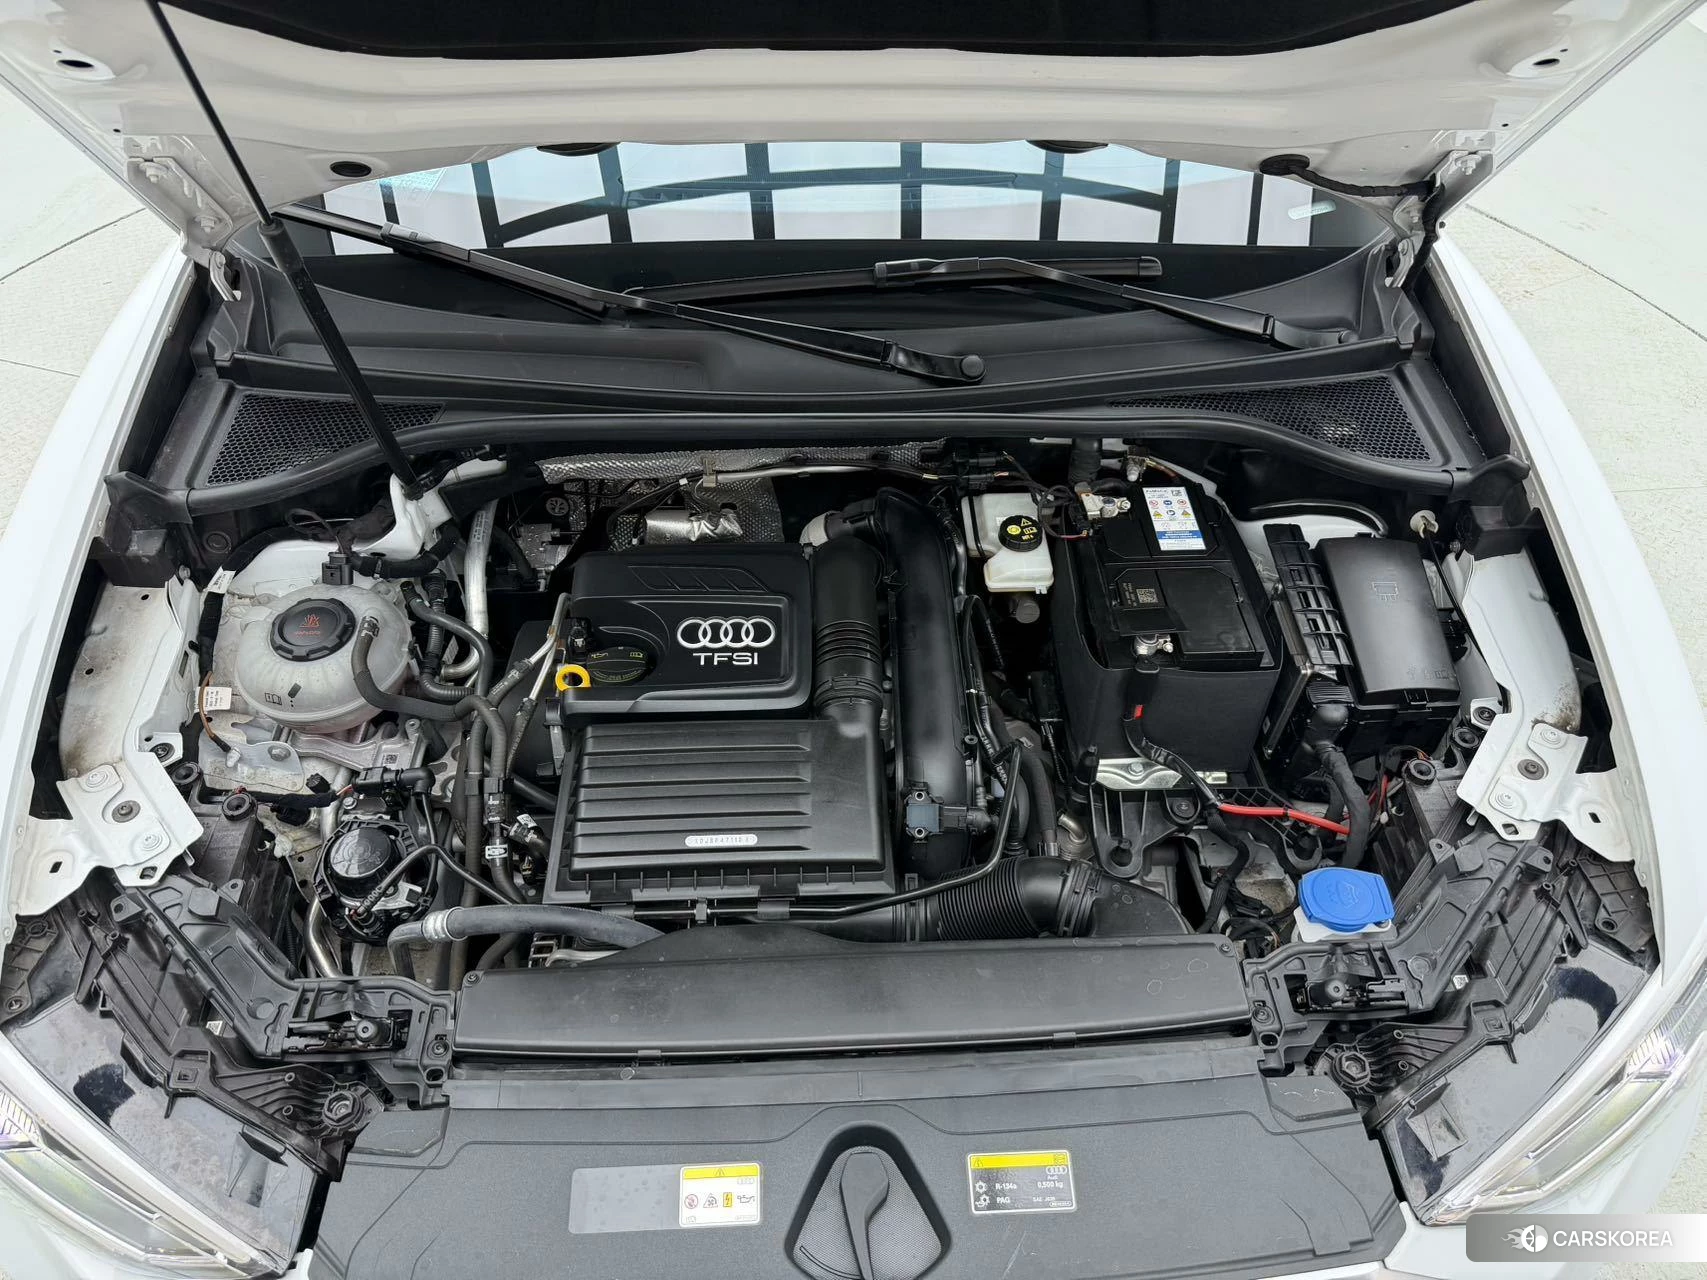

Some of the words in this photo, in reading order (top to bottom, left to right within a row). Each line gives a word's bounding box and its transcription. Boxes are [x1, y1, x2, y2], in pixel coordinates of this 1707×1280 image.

[693, 652, 758, 666] TFSI
[995, 1182, 1017, 1190] R-134a
[1055, 1181, 1064, 1189] kg
[996, 1196, 1011, 1204] PAG
